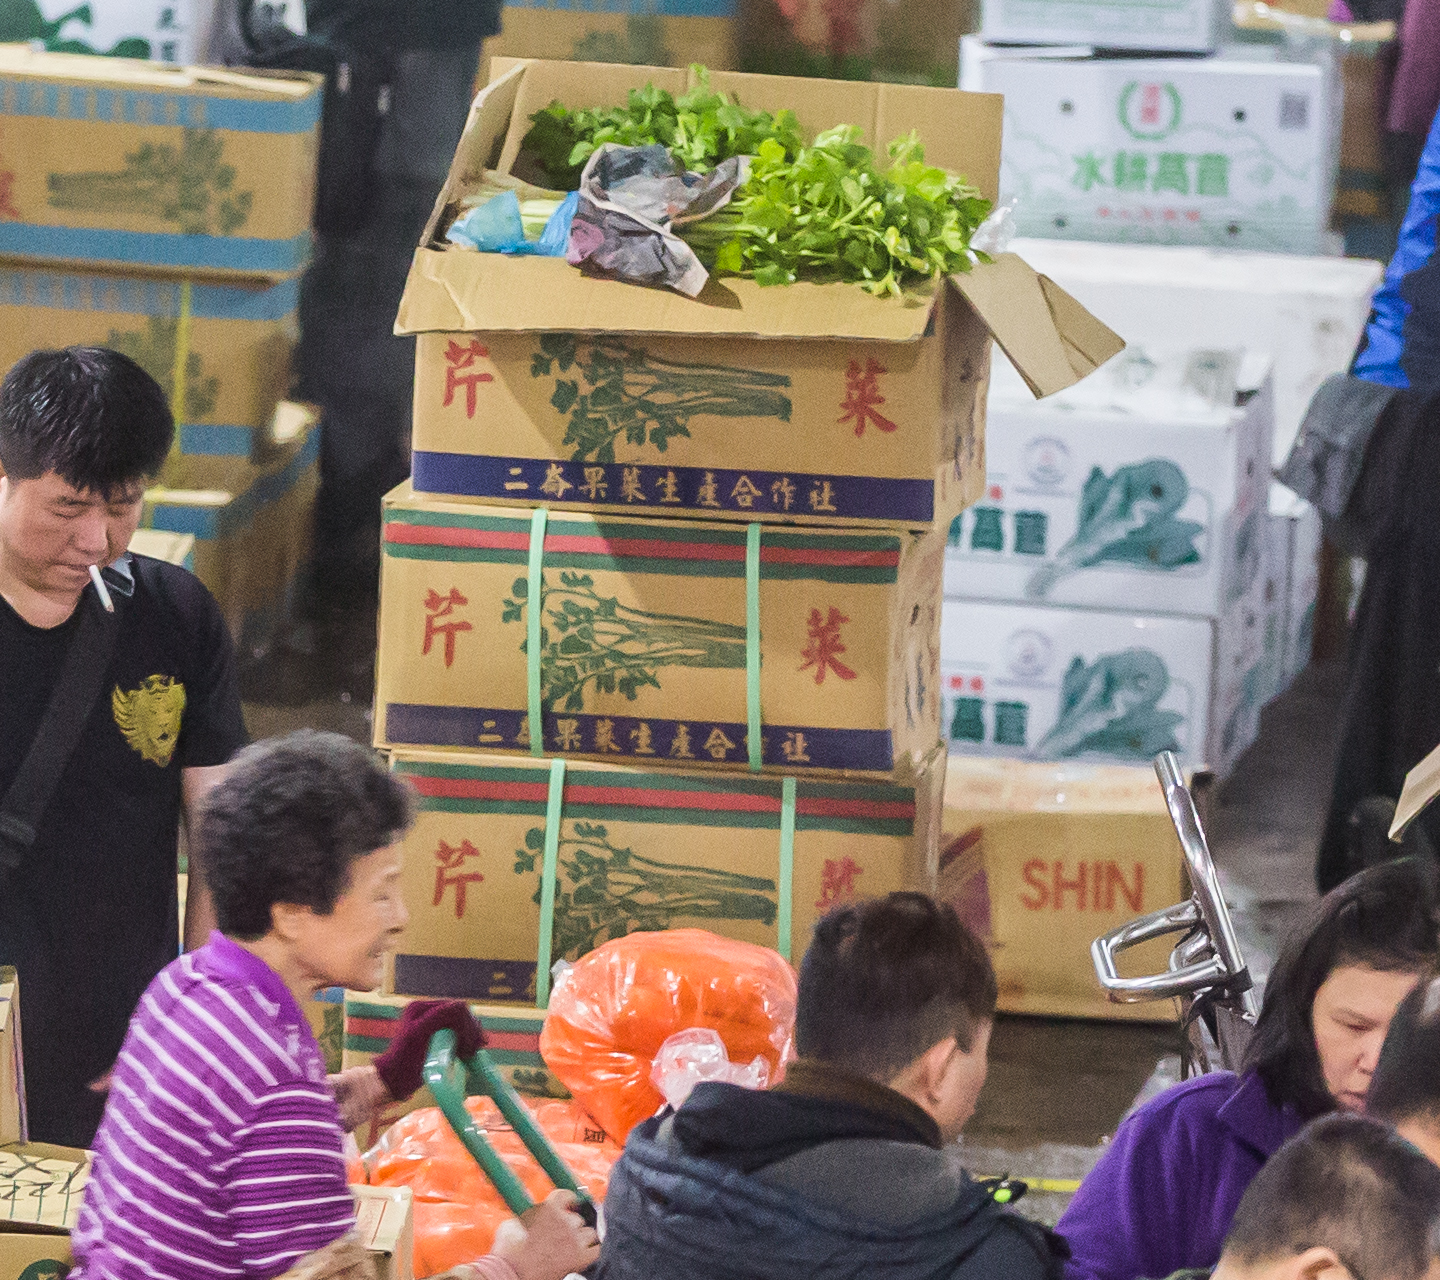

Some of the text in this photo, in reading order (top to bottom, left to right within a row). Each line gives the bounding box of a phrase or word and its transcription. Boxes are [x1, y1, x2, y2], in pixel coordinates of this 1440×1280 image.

[441, 339, 898, 438] 芹 菜
[420, 587, 858, 685] 芹 菜
[431, 838, 484, 919] 芹
[1020, 859, 1145, 913] SHIN
